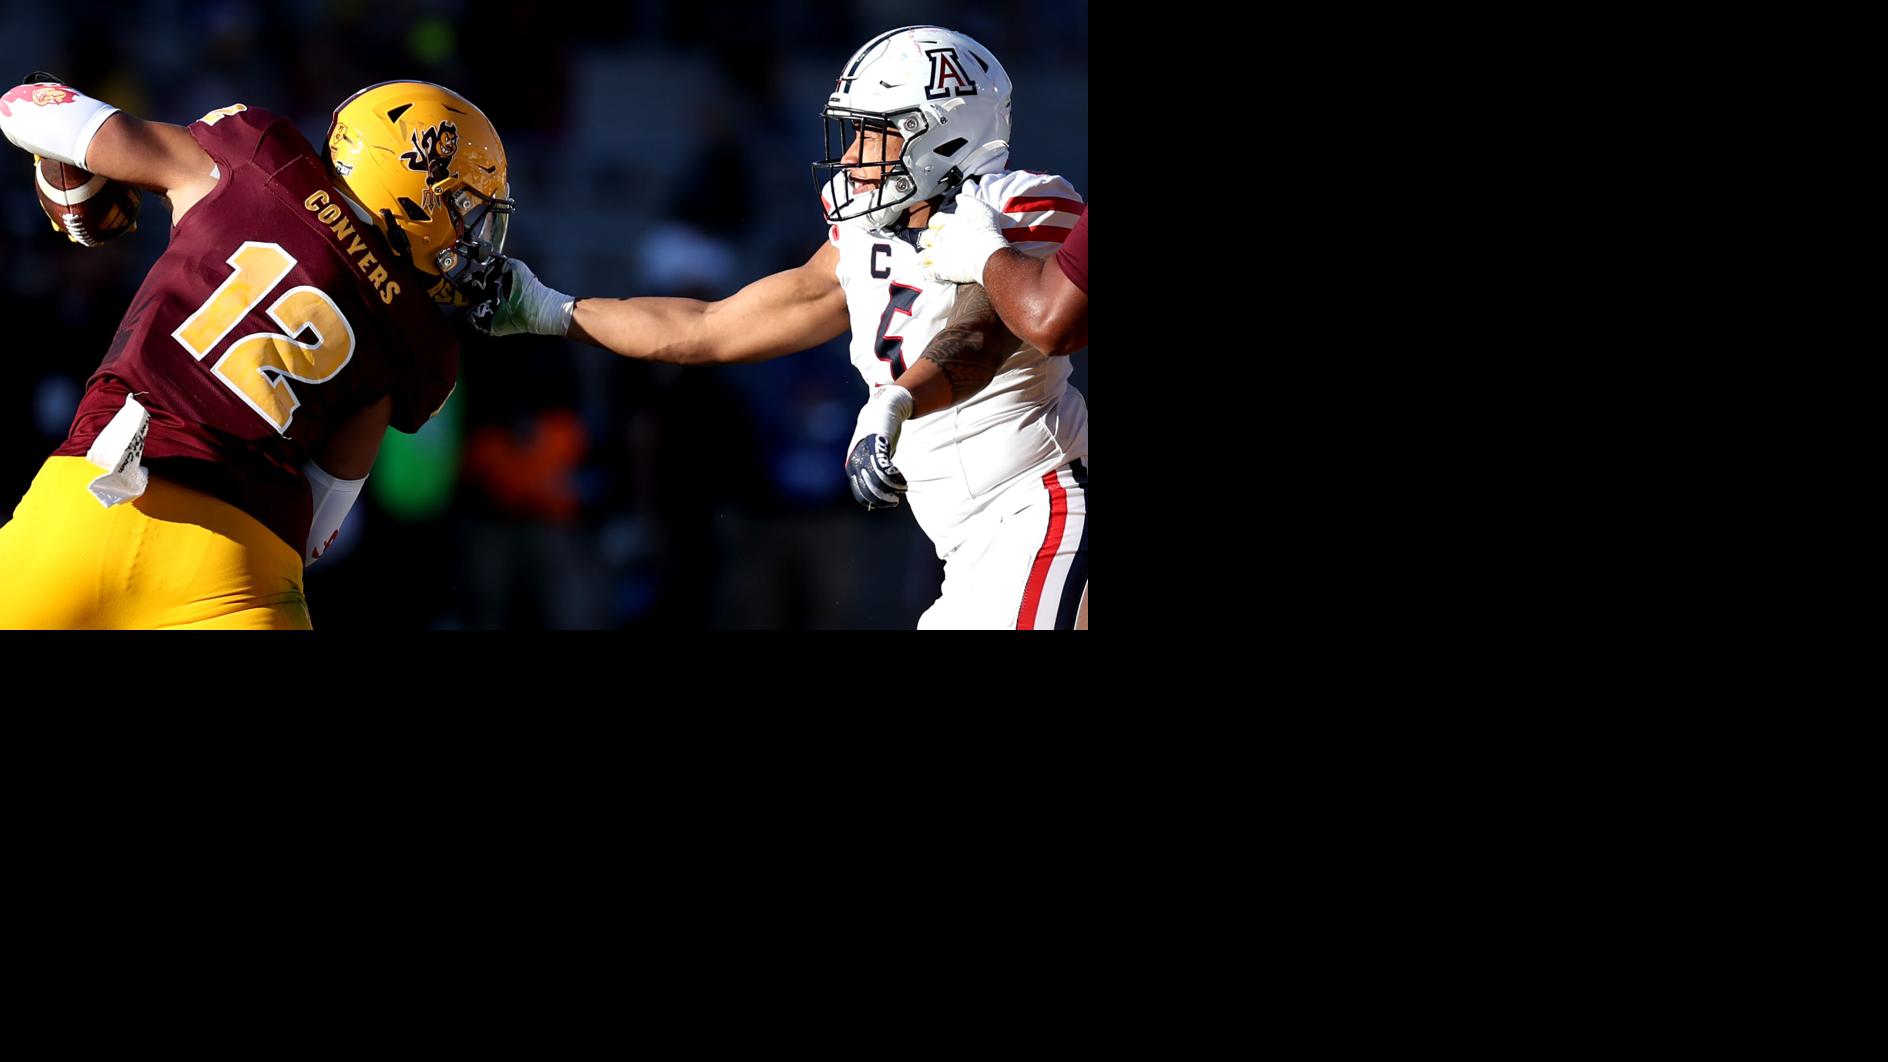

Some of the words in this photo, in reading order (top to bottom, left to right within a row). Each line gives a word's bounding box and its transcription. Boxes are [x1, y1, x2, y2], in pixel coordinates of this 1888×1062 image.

[925, 48, 978, 101] A
[304, 190, 401, 305] CONYERS
[870, 243, 892, 279] C
[171, 241, 356, 435] 12
